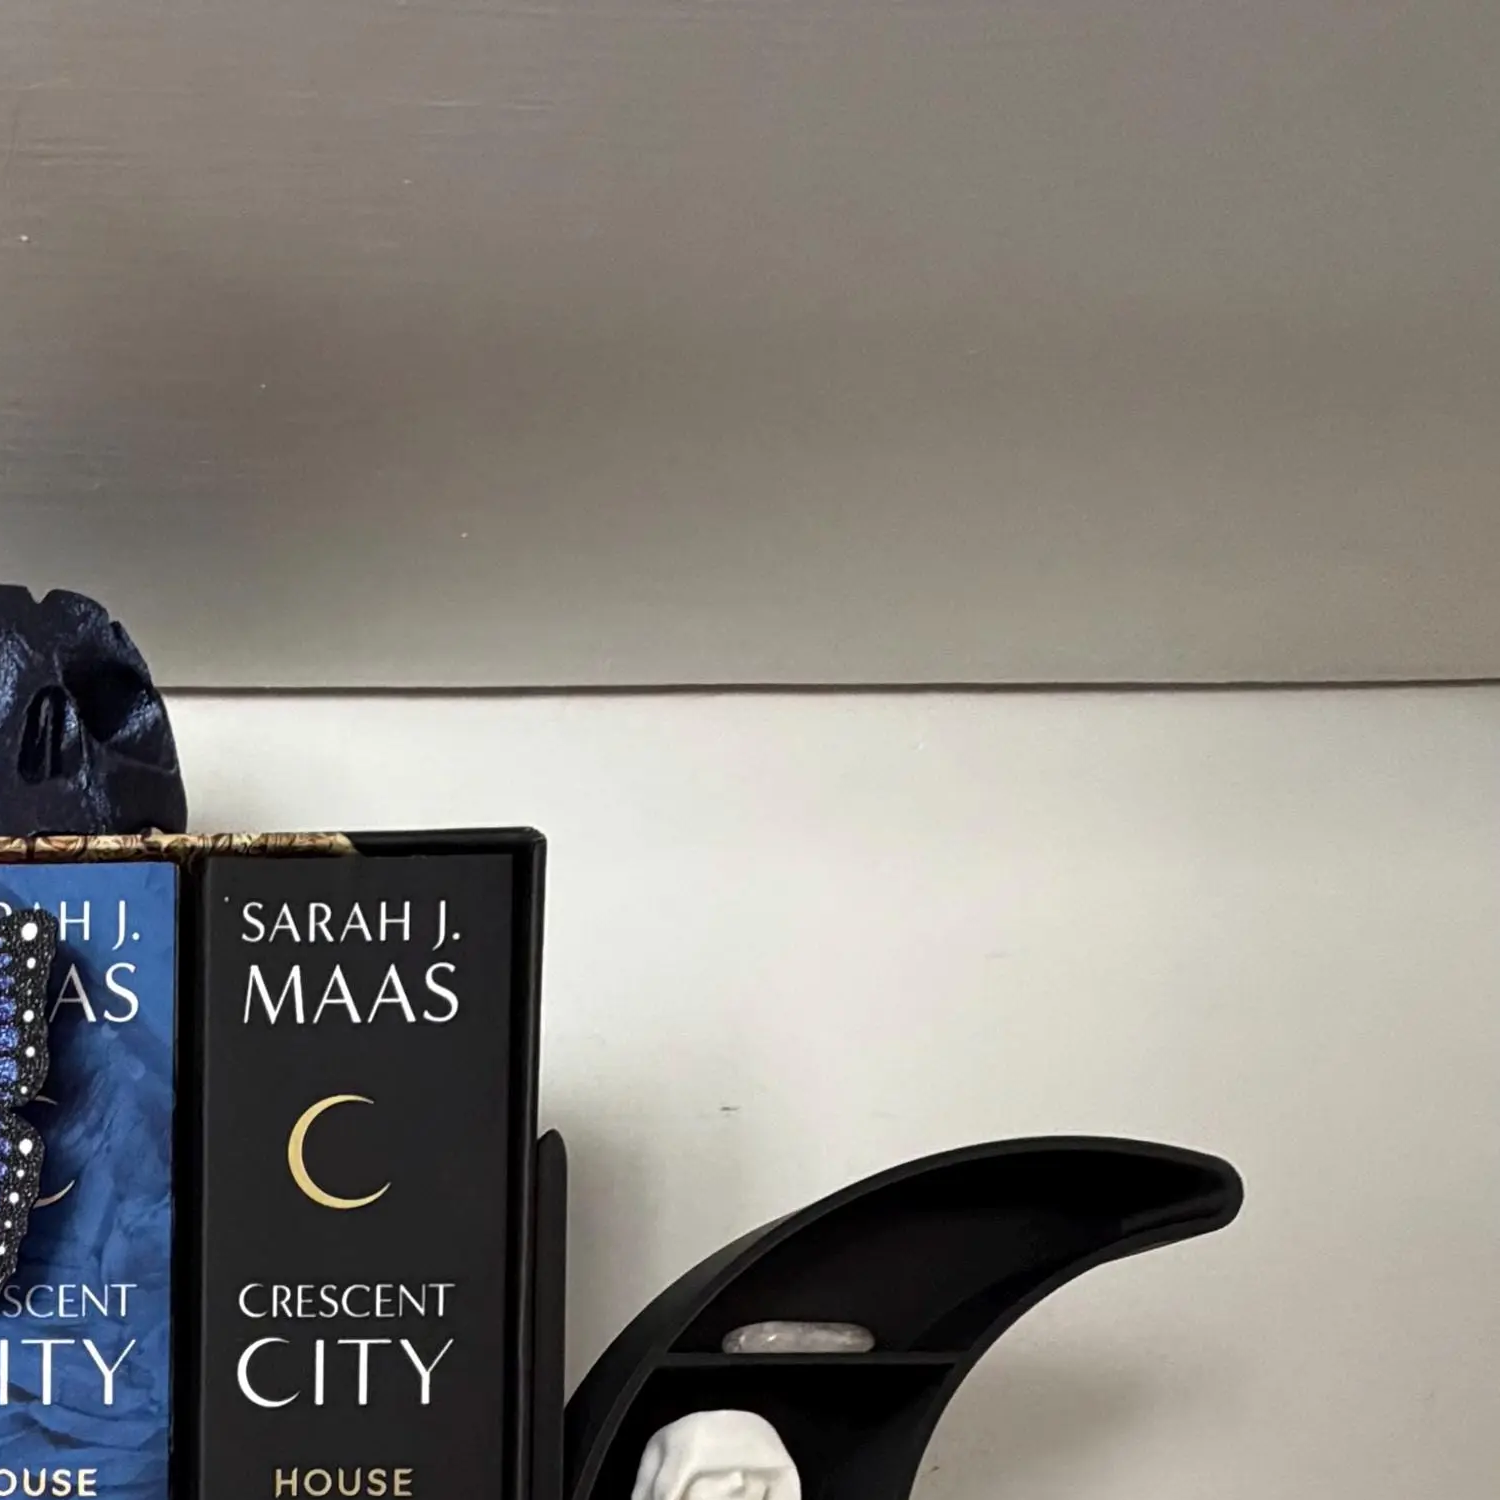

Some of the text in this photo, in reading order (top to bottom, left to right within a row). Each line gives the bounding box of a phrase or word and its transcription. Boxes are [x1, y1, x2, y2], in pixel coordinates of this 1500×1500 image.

[112, 900, 141, 950] J.
[241, 900, 461, 950] SARAH J.
[243, 961, 460, 1024] MAAS
[238, 1283, 456, 1318] CRESCENT
[237, 1337, 454, 1408] CITY
[274, 1467, 414, 1498] HOUSE
